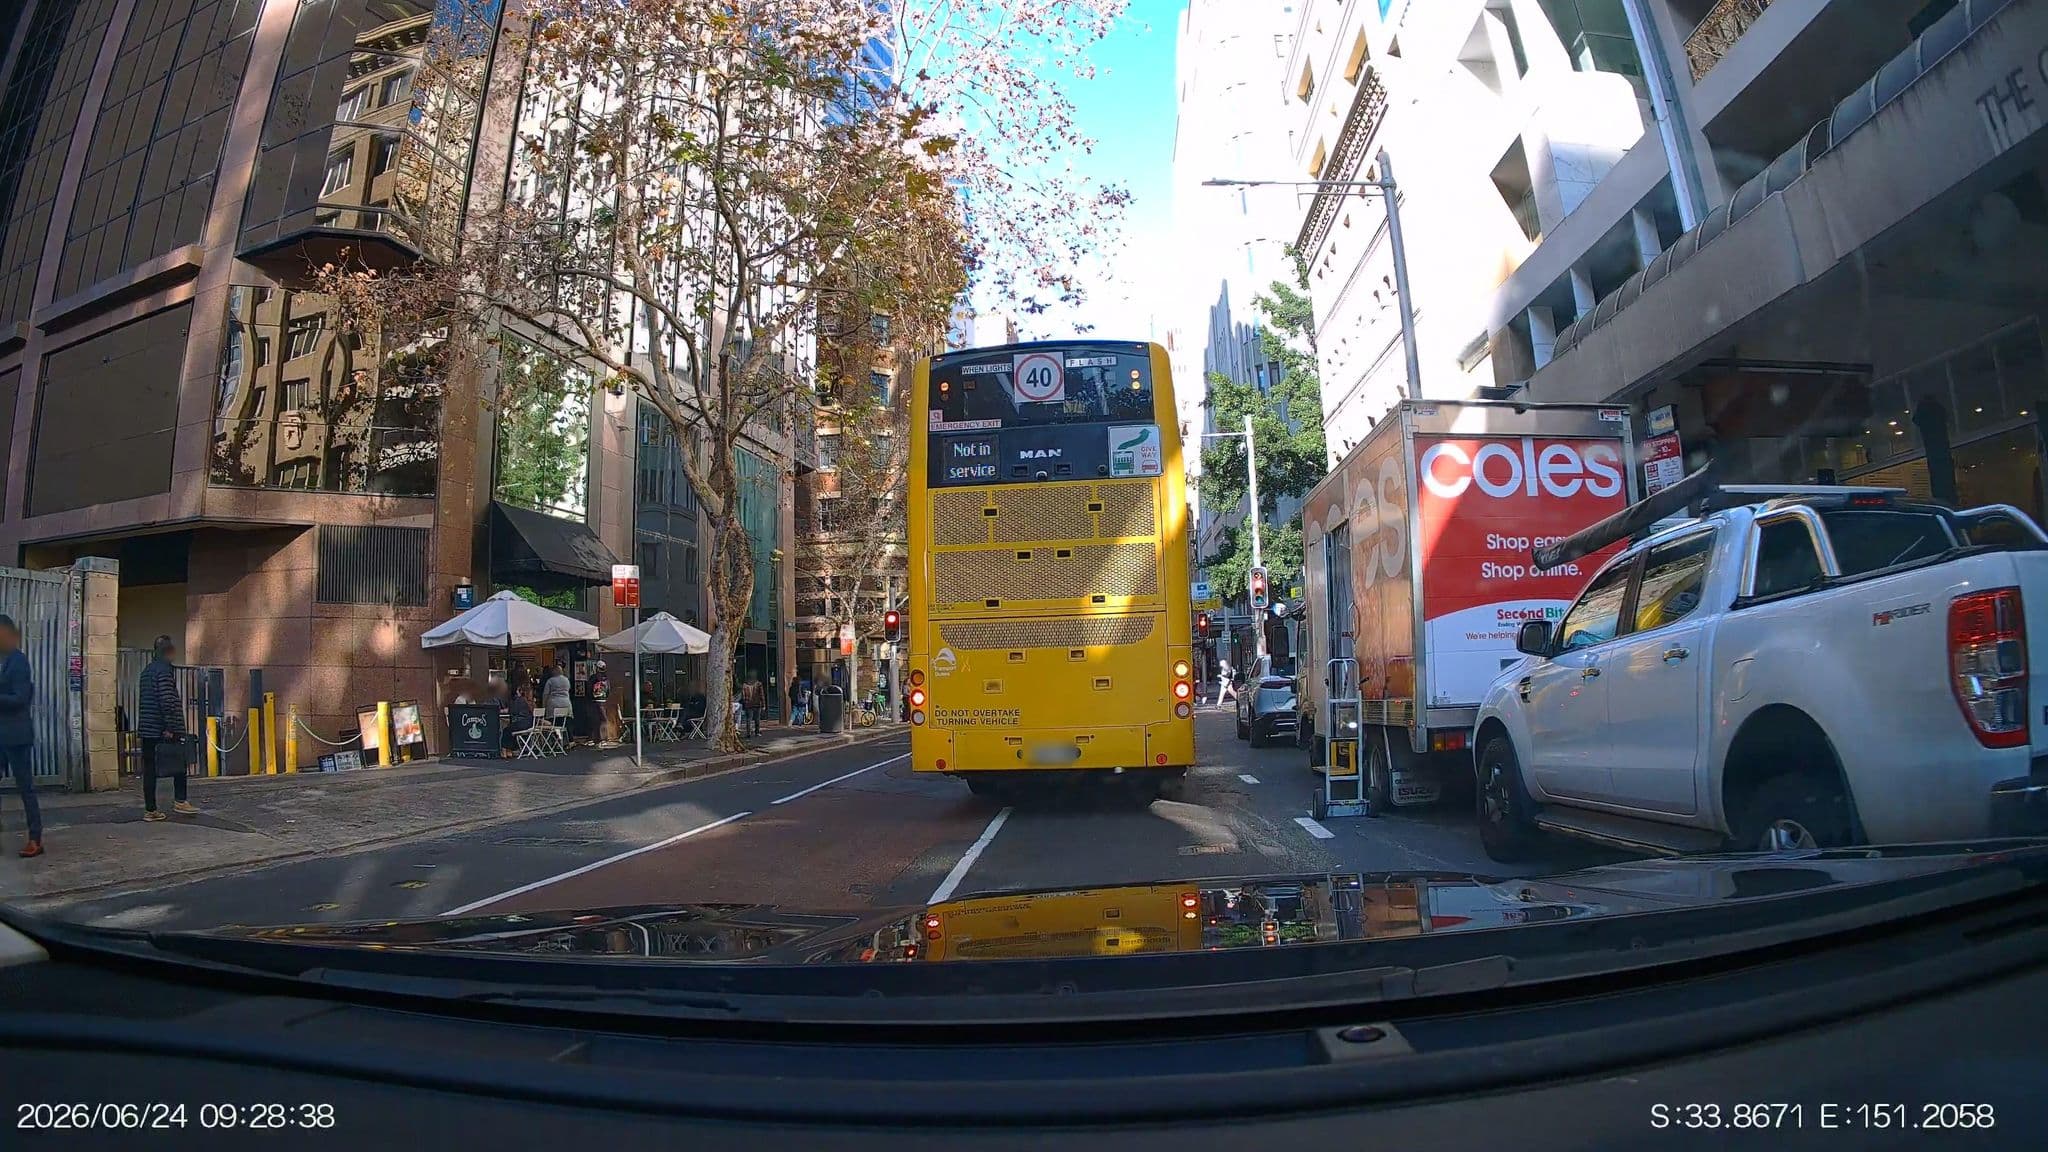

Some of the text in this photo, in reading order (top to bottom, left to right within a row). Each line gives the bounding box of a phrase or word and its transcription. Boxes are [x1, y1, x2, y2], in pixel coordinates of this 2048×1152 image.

[1976, 65, 2034, 130] THE
[962, 365, 984, 374] WHEN
[1026, 367, 1052, 388] 40
[931, 420, 999, 430] EMERGENCY EXIT
[953, 443, 991, 457] Not in
[1020, 448, 1062, 459] MAN
[949, 464, 996, 478] service
[1420, 436, 1622, 497] coles
[1486, 533, 1530, 552] Shop
[1481, 561, 1525, 580] Shop
[935, 709, 1020, 717] DO NOT OVERTAKE
[937, 717, 1019, 726] TURNING VEHICLE
